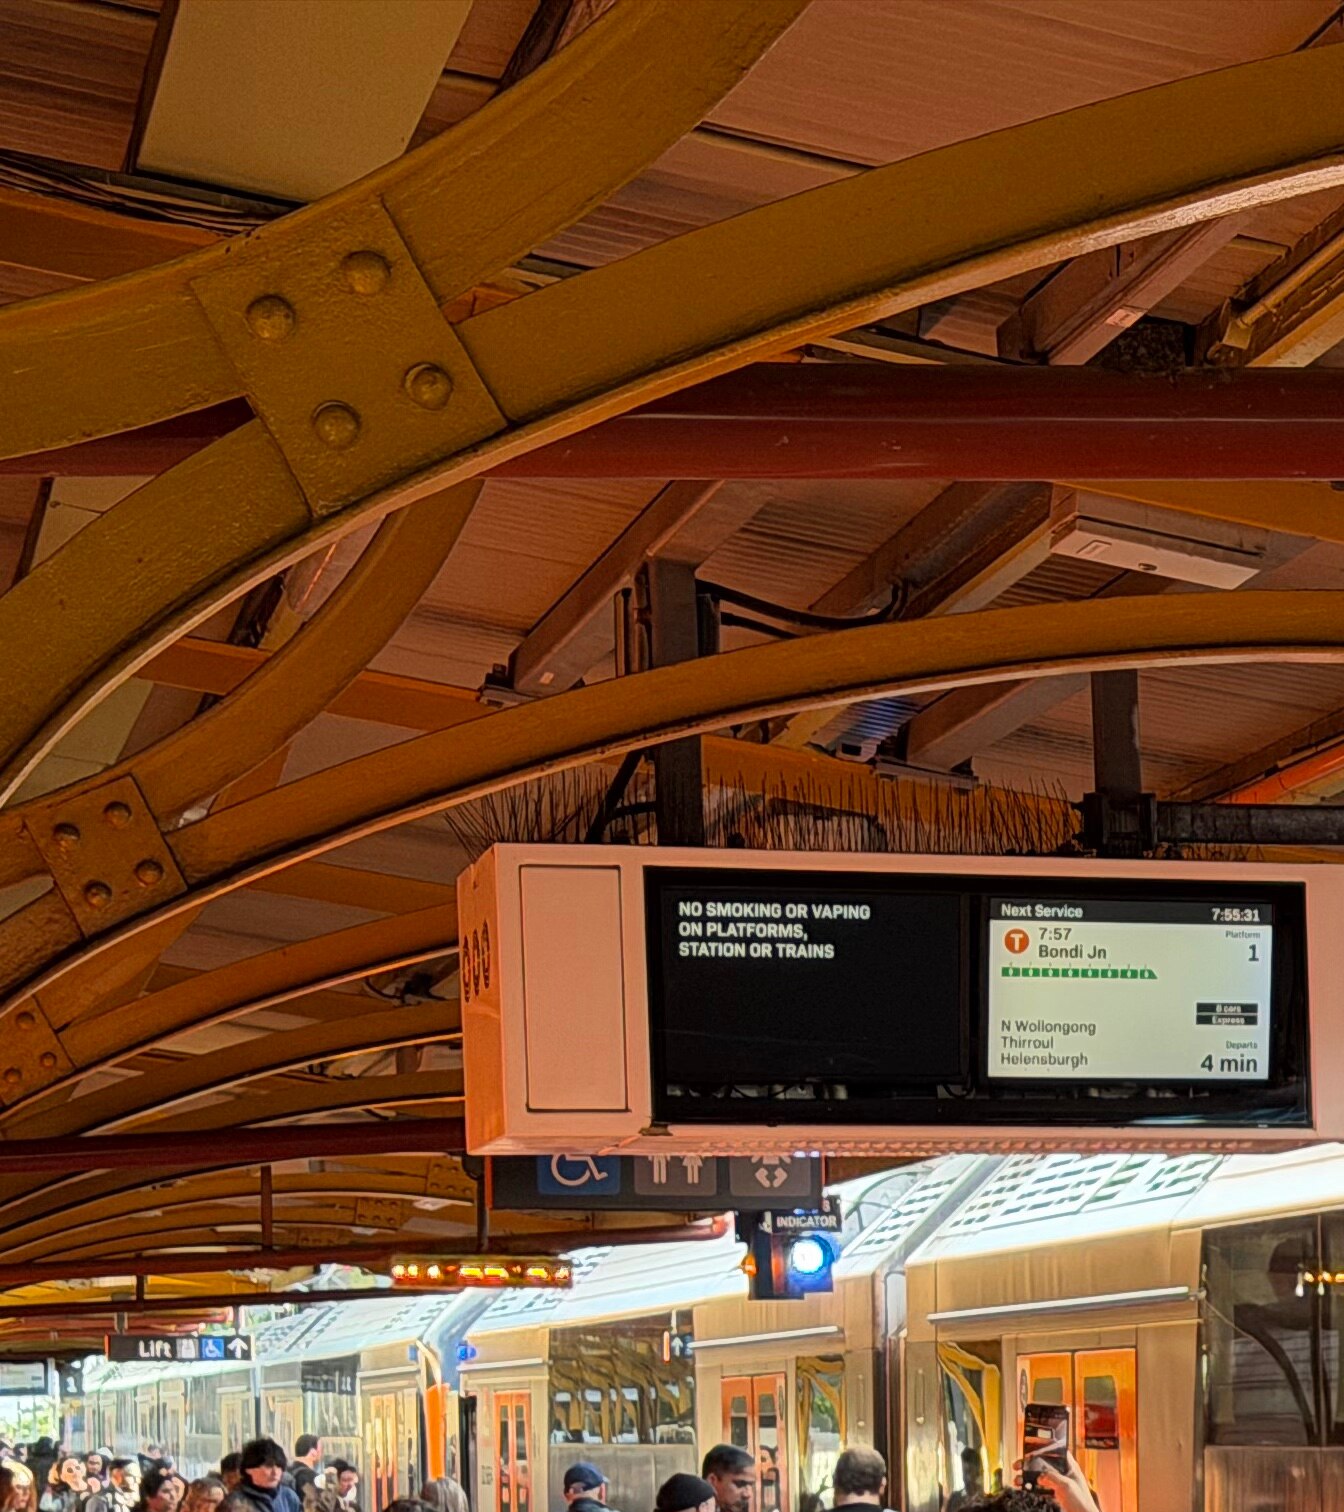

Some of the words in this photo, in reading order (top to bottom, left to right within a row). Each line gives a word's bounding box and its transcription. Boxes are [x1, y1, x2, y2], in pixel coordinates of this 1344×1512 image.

[679, 901, 702, 917] NO
[706, 902, 781, 918] SMOKING
[785, 903, 808, 918] OR
[811, 904, 871, 920] VAPING
[1001, 903, 1032, 918] Next
[1035, 904, 1083, 919] Service
[1211, 907, 1260, 922] 7:55:31
[679, 922, 702, 937] ON
[706, 922, 808, 941] PLATFORMS,
[1038, 928, 1072, 941] 7:57
[1225, 930, 1261, 939] Platform
[679, 941, 746, 957] STATION
[749, 942, 773, 958] OR
[776, 943, 835, 959] TRAINS
[1038, 944, 1083, 959] Bondi
[1087, 945, 1107, 960] Jn
[1248, 944, 1260, 962] 1
[1001, 1019, 1011, 1032] N
[1015, 1019, 1096, 1036] Wollongong
[1000, 1035, 1054, 1049] Thirroul
[1225, 1039, 1258, 1050] Departs
[1000, 1051, 1088, 1070] Helensburgh
[1200, 1054, 1214, 1073] 4
[1220, 1054, 1258, 1073] min
[776, 1215, 838, 1229] INDICATOR
[138, 1340, 173, 1358] Lift
